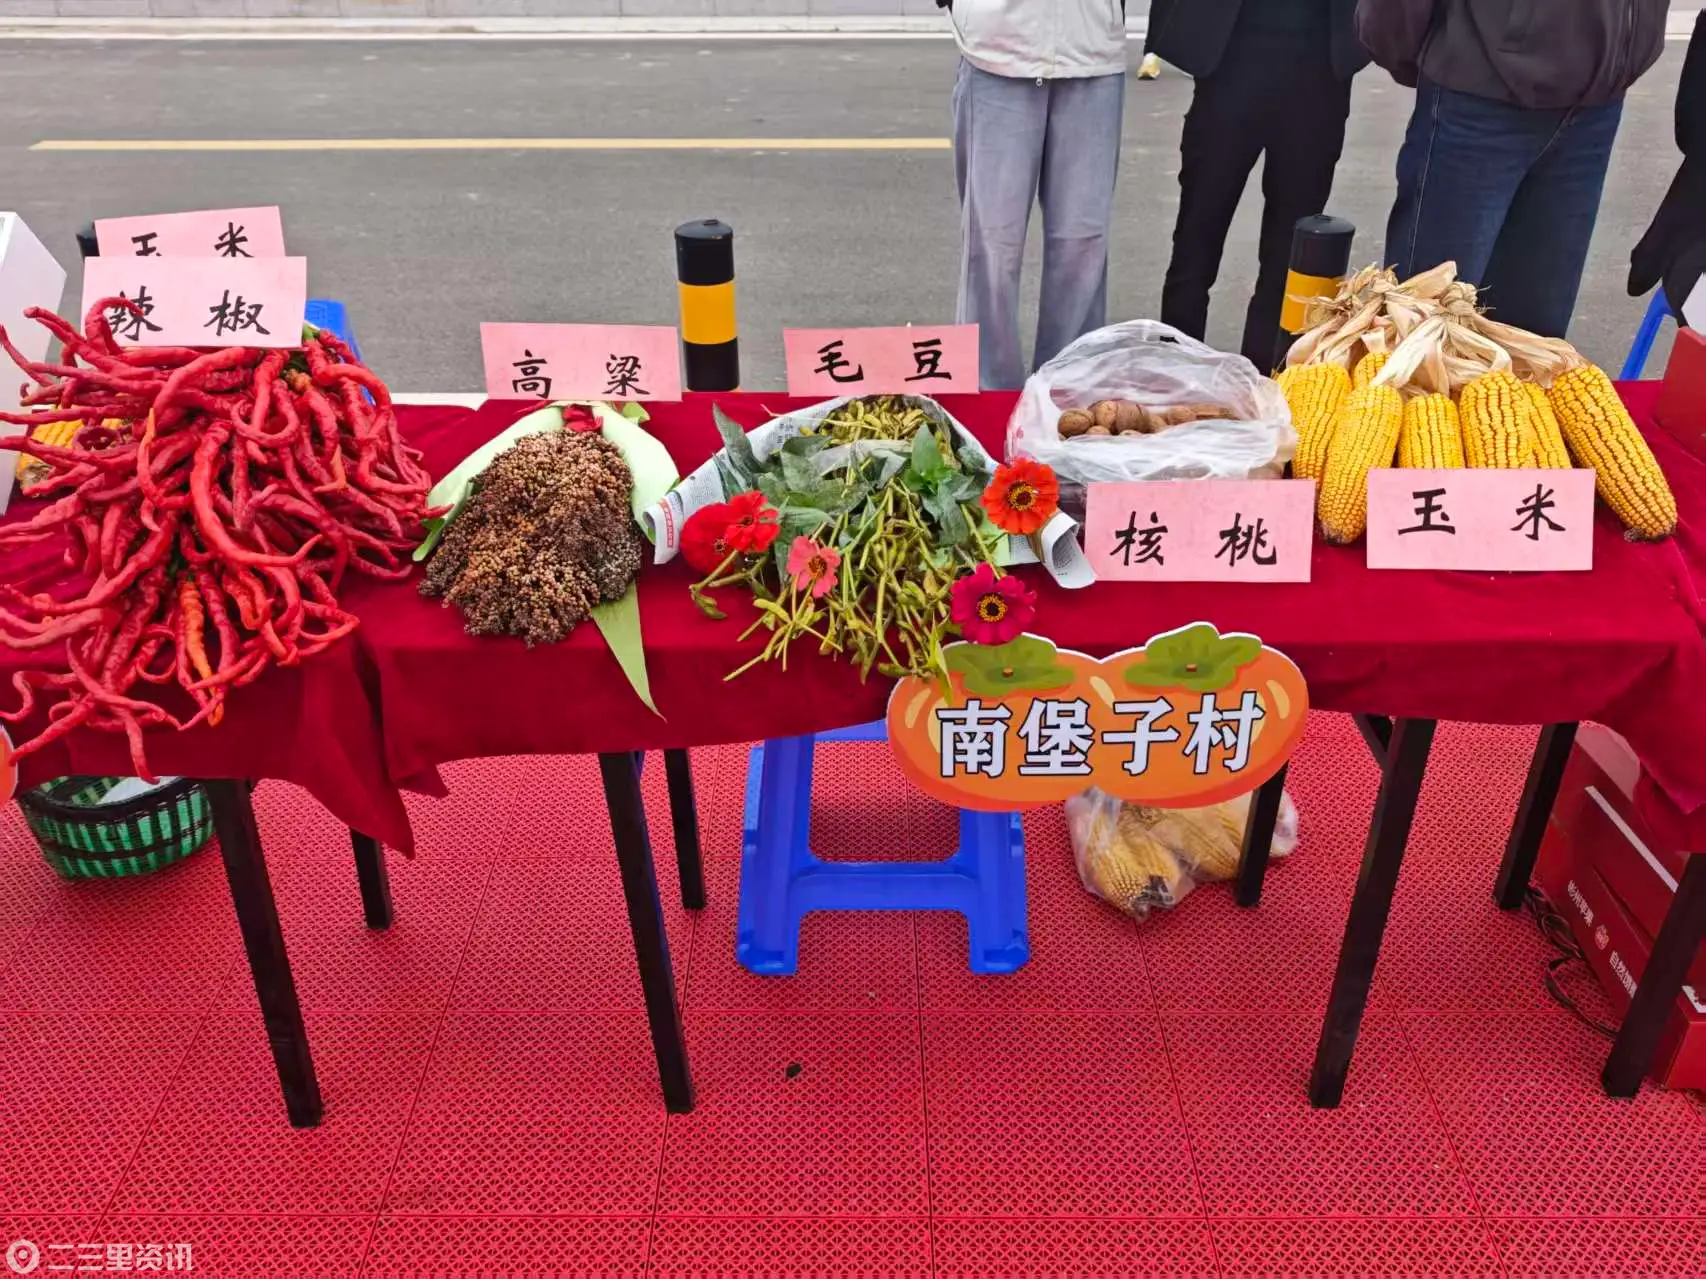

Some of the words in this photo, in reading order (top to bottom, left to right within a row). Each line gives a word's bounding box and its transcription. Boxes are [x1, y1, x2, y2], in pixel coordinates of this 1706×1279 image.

[109, 286, 271, 341] 辣椒
[512, 349, 650, 399] 高粱
[814, 339, 952, 383] 毛豆
[1109, 511, 1277, 567] 核桃
[1398, 483, 1566, 541] 玉米
[935, 690, 1266, 778] 南堡子村
